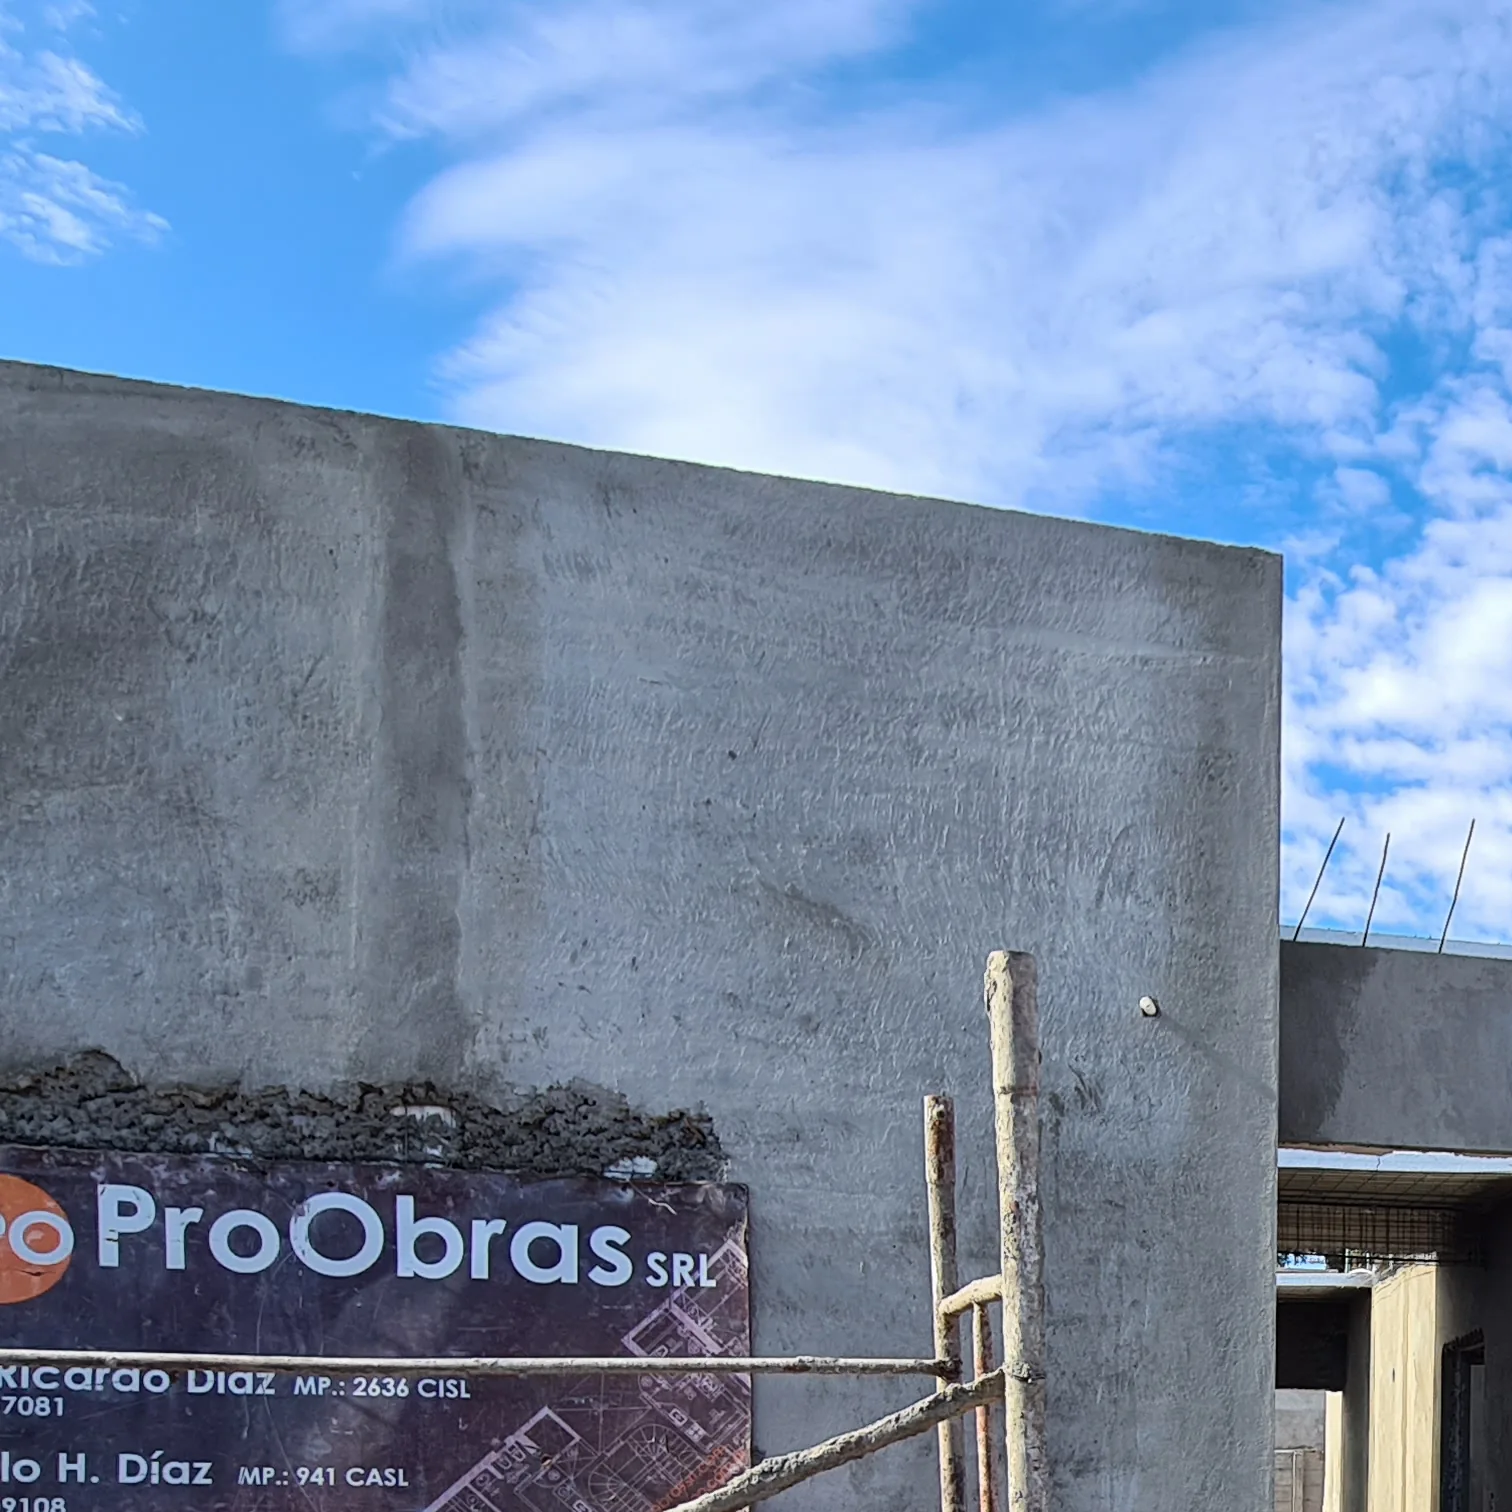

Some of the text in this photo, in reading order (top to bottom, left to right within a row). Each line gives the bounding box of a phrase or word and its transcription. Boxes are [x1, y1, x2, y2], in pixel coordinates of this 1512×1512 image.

[97, 1183, 634, 1287] ProObras
[645, 1251, 717, 1288] SRL
[293, 1375, 346, 1397] MP.:
[352, 1376, 410, 1398] 2636
[417, 1378, 472, 1399] CISL
[58, 1452, 100, 1484] H.
[118, 1450, 214, 1485] Díaz
[237, 1466, 289, 1486] MP.:
[296, 1467, 337, 1486] 941
[345, 1467, 410, 1487] CASL
